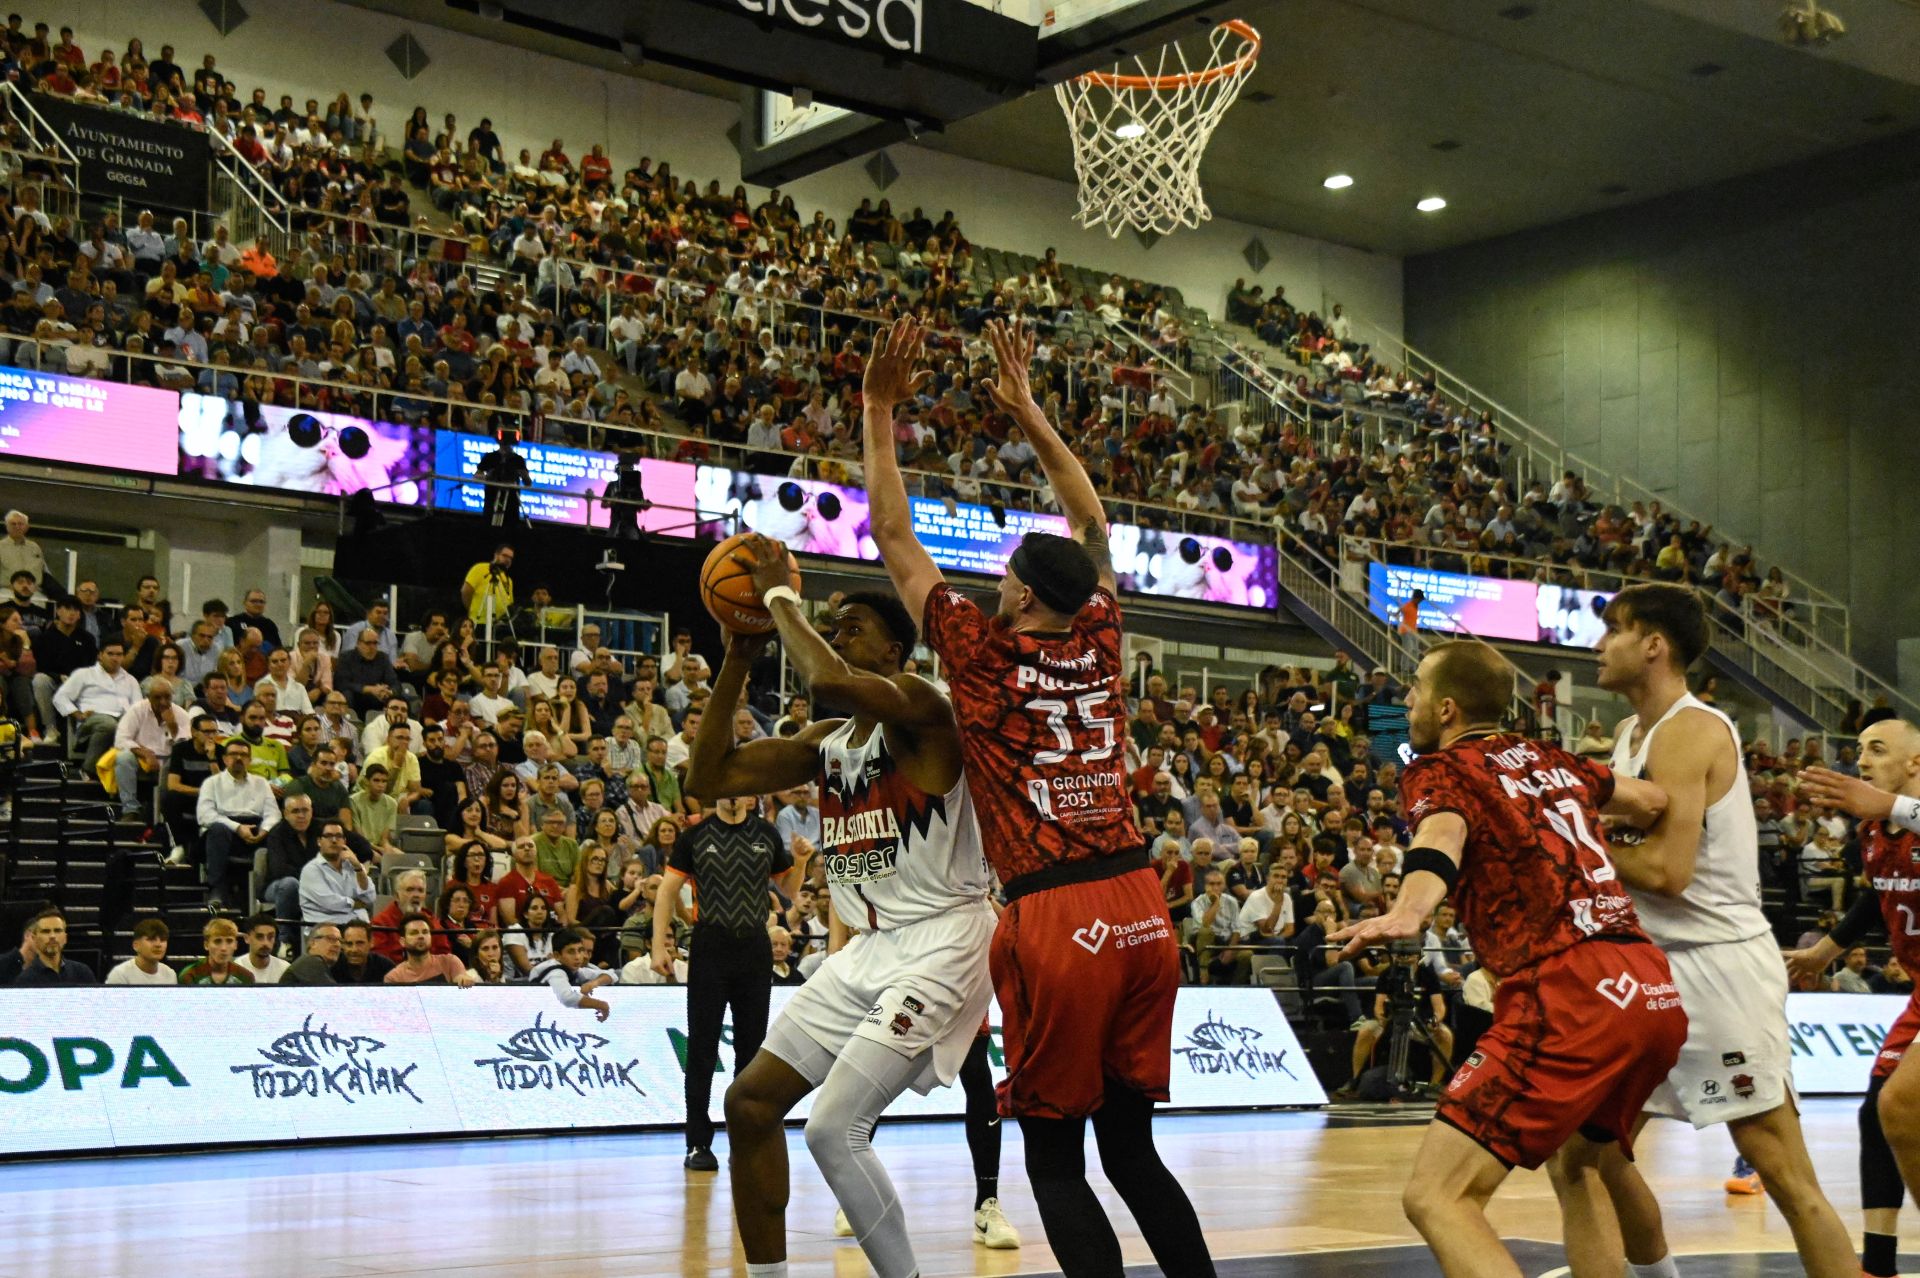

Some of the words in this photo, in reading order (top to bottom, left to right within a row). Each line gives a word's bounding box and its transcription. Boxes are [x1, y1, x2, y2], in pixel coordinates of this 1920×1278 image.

[77, 146, 96, 159] DE
[102, 147, 173, 175] GRANADA
[36, 378, 55, 392] TE
[51, 394, 83, 408] QUE
[546, 451, 588, 467] NUNCA
[1025, 690, 1116, 765] 35
[1053, 772, 1121, 790] GRANADA
[1057, 791, 1094, 809] 2031
[1173, 1046, 1298, 1081] TODOKAYAK
[230, 1059, 423, 1104] TODOKAYAK
[474, 1056, 647, 1097] TODOKAYAK
